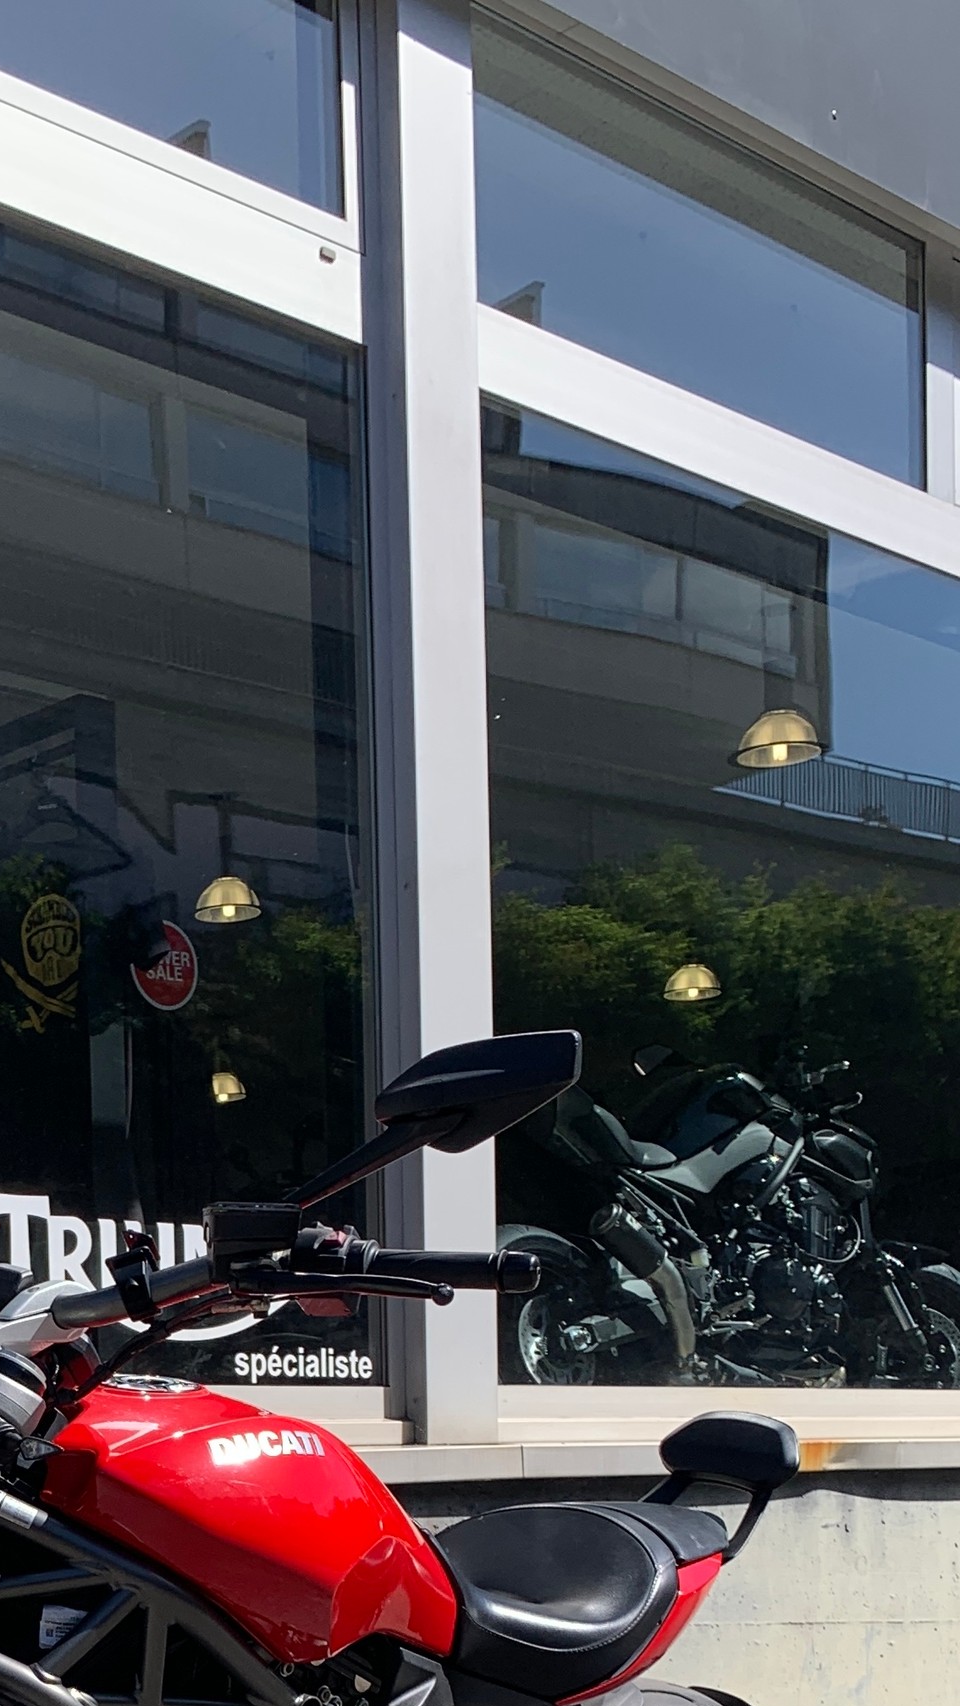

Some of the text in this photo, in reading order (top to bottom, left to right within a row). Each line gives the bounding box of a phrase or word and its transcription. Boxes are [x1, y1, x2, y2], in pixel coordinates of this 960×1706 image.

[145, 964, 184, 983] SALE
[234, 1345, 373, 1384] spécialiste
[207, 1430, 325, 1467] DUCATI
